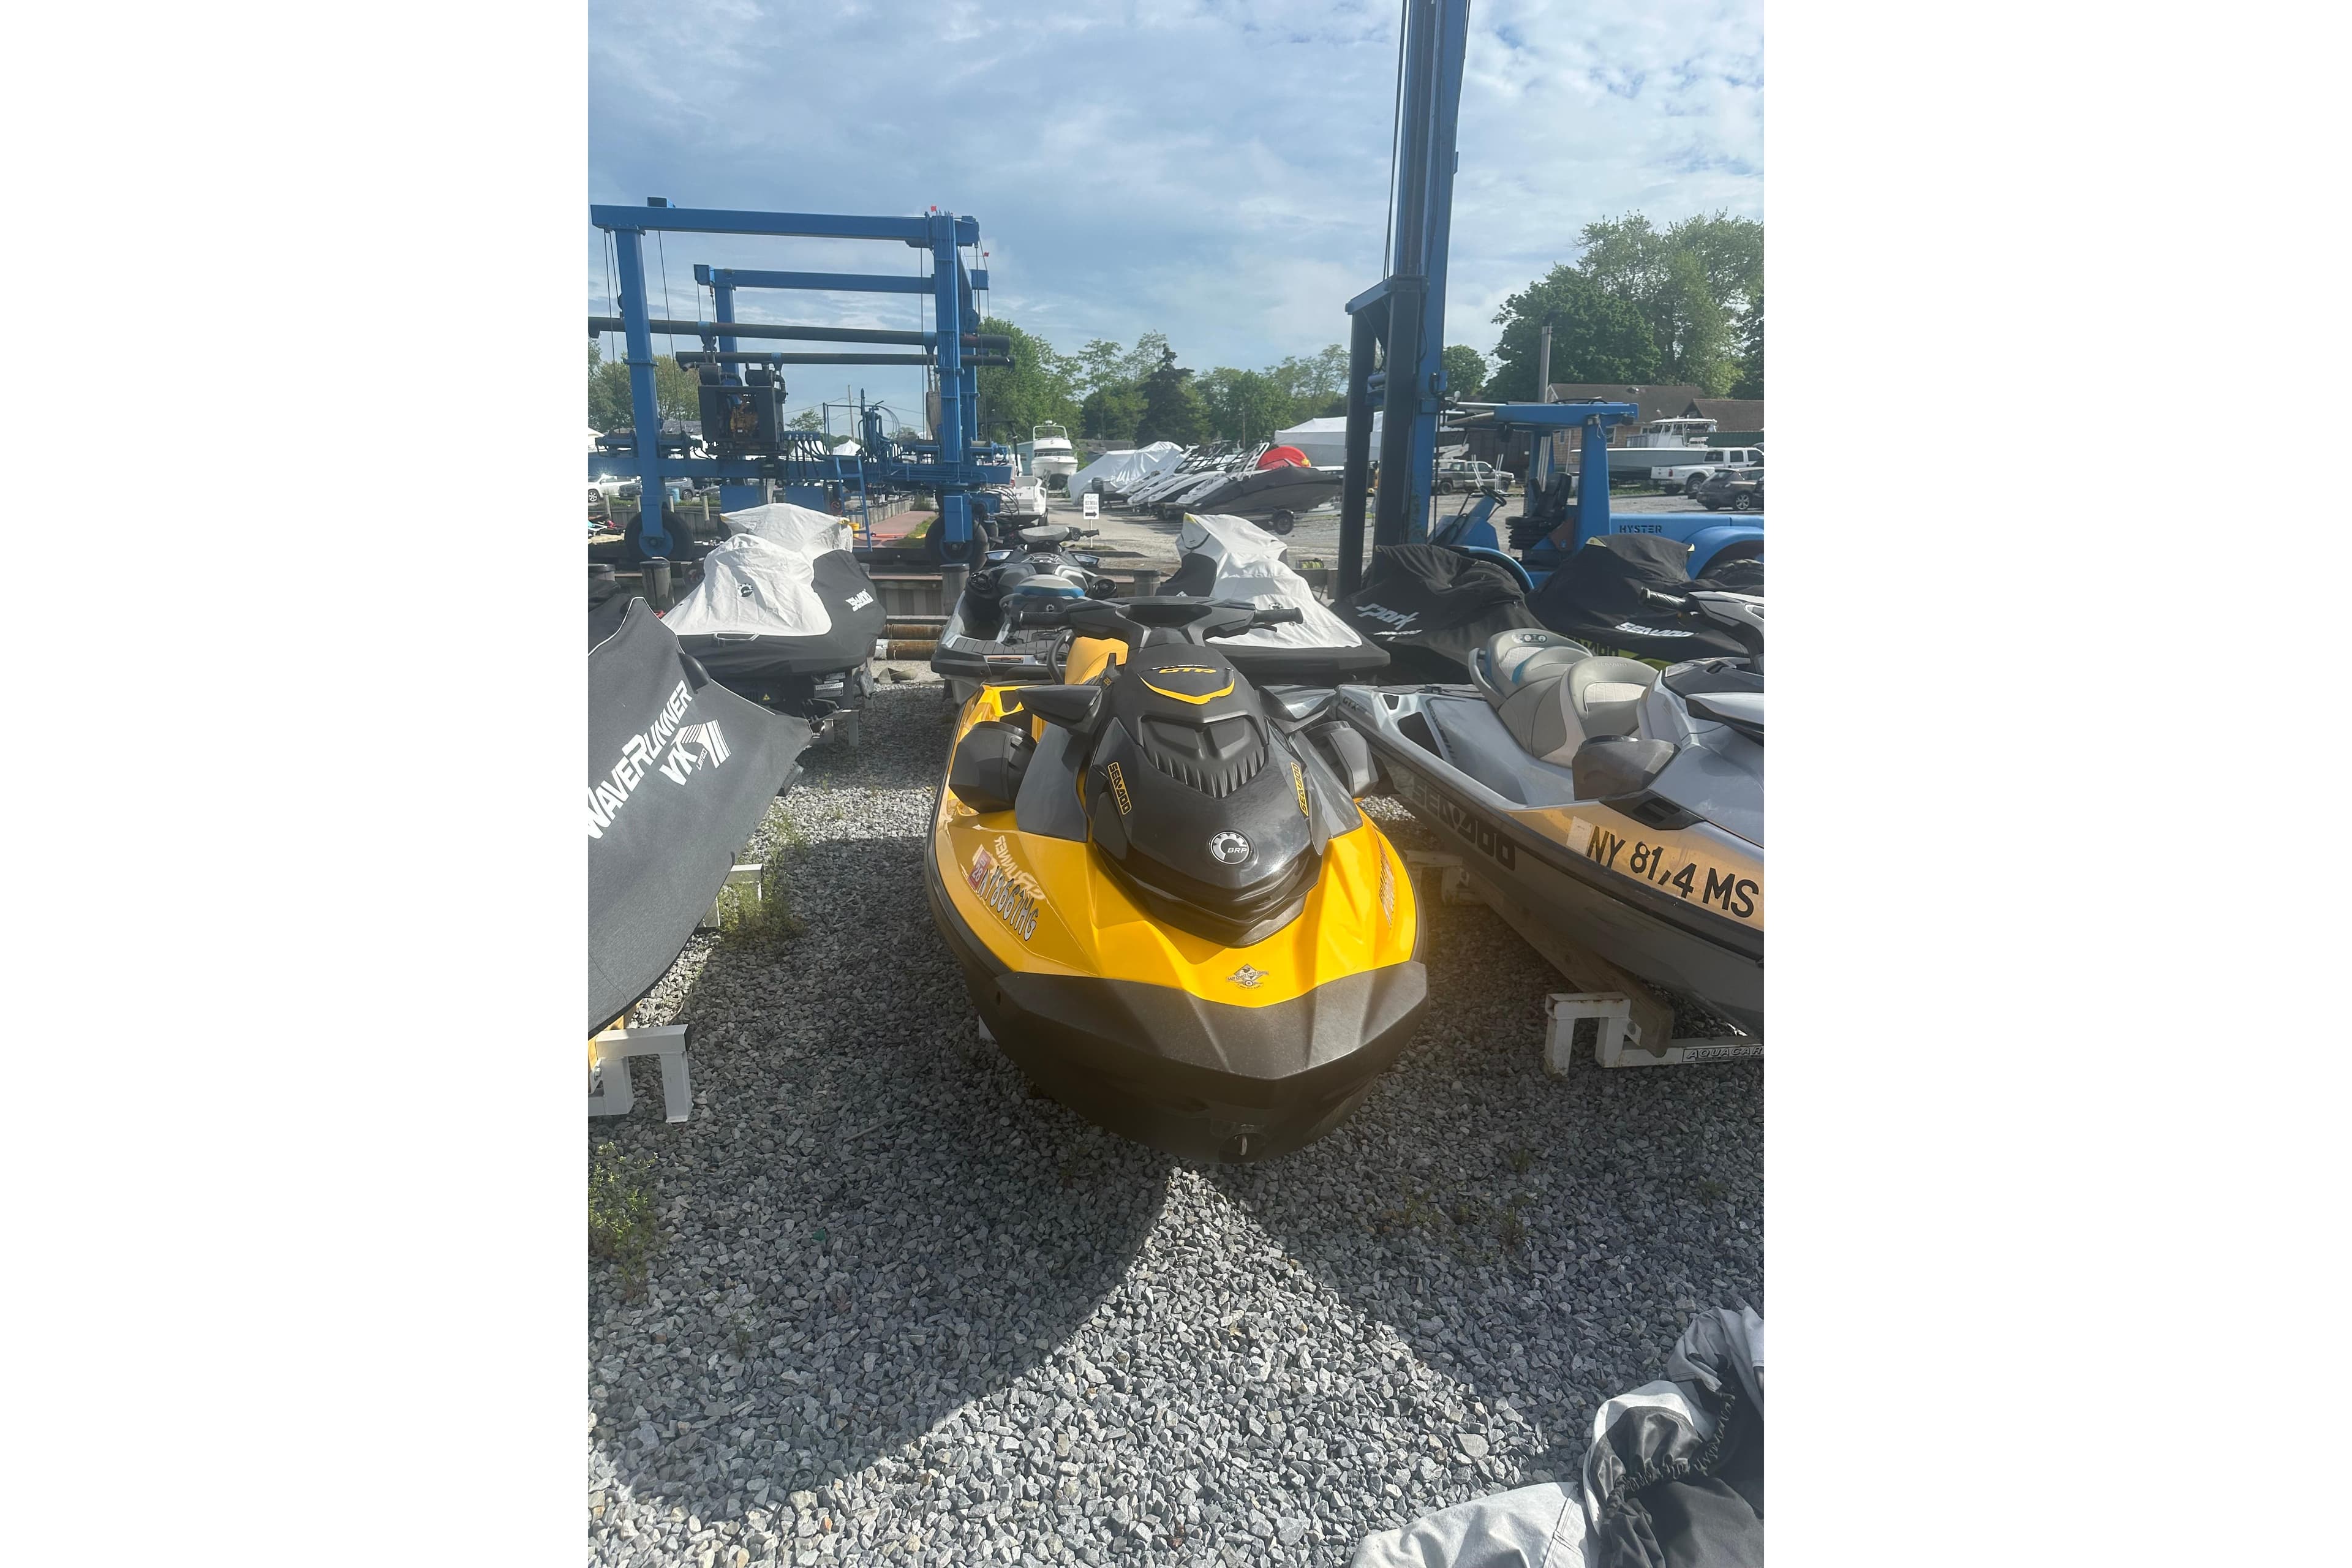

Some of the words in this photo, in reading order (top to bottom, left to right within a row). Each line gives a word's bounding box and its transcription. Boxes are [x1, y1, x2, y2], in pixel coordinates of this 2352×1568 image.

[1619, 525, 1662, 533] HYSTER
[1587, 826, 1626, 869] NY
[1702, 868, 1759, 918] MS
